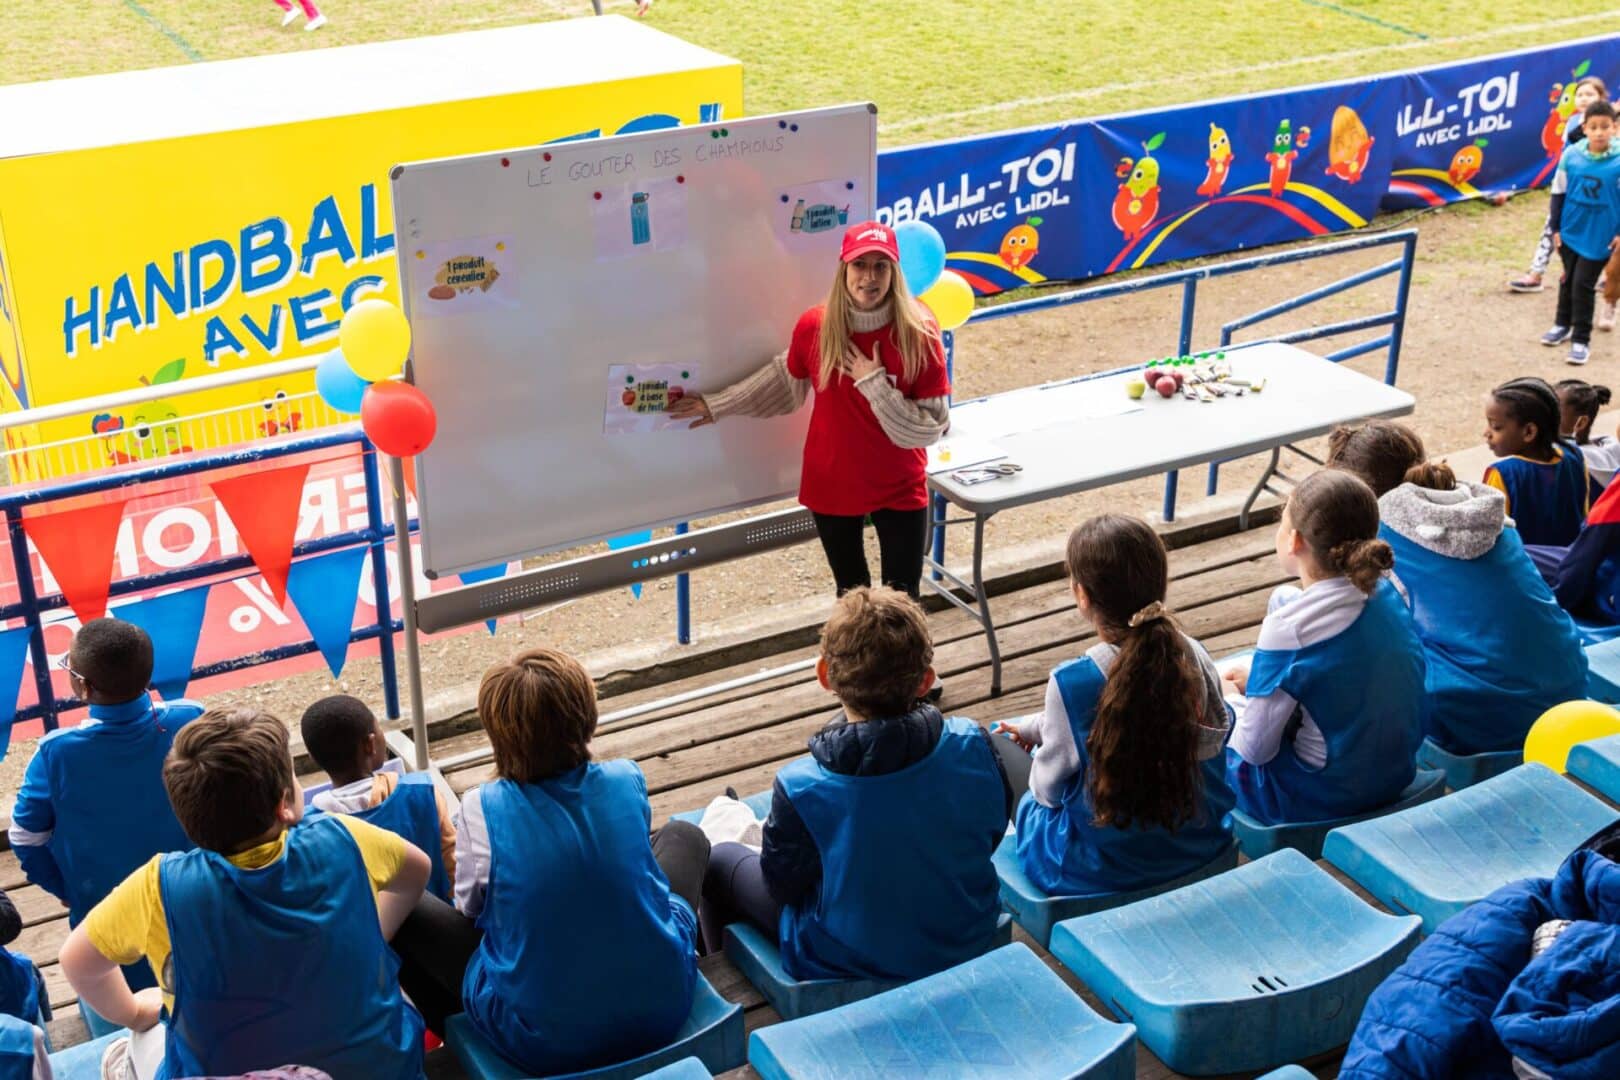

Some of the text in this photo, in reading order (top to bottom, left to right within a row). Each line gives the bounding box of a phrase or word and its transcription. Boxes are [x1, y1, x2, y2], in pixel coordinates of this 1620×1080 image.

[1396, 71, 1520, 137] LL-TOI
[1415, 112, 1512, 148] AVEC LIDL
[527, 166, 552, 188] LE
[652, 147, 682, 169] DES
[694, 136, 786, 163] CHAMPIONS
[955, 187, 1070, 229] AVEC LIDL
[452, 256, 485, 273] produit
